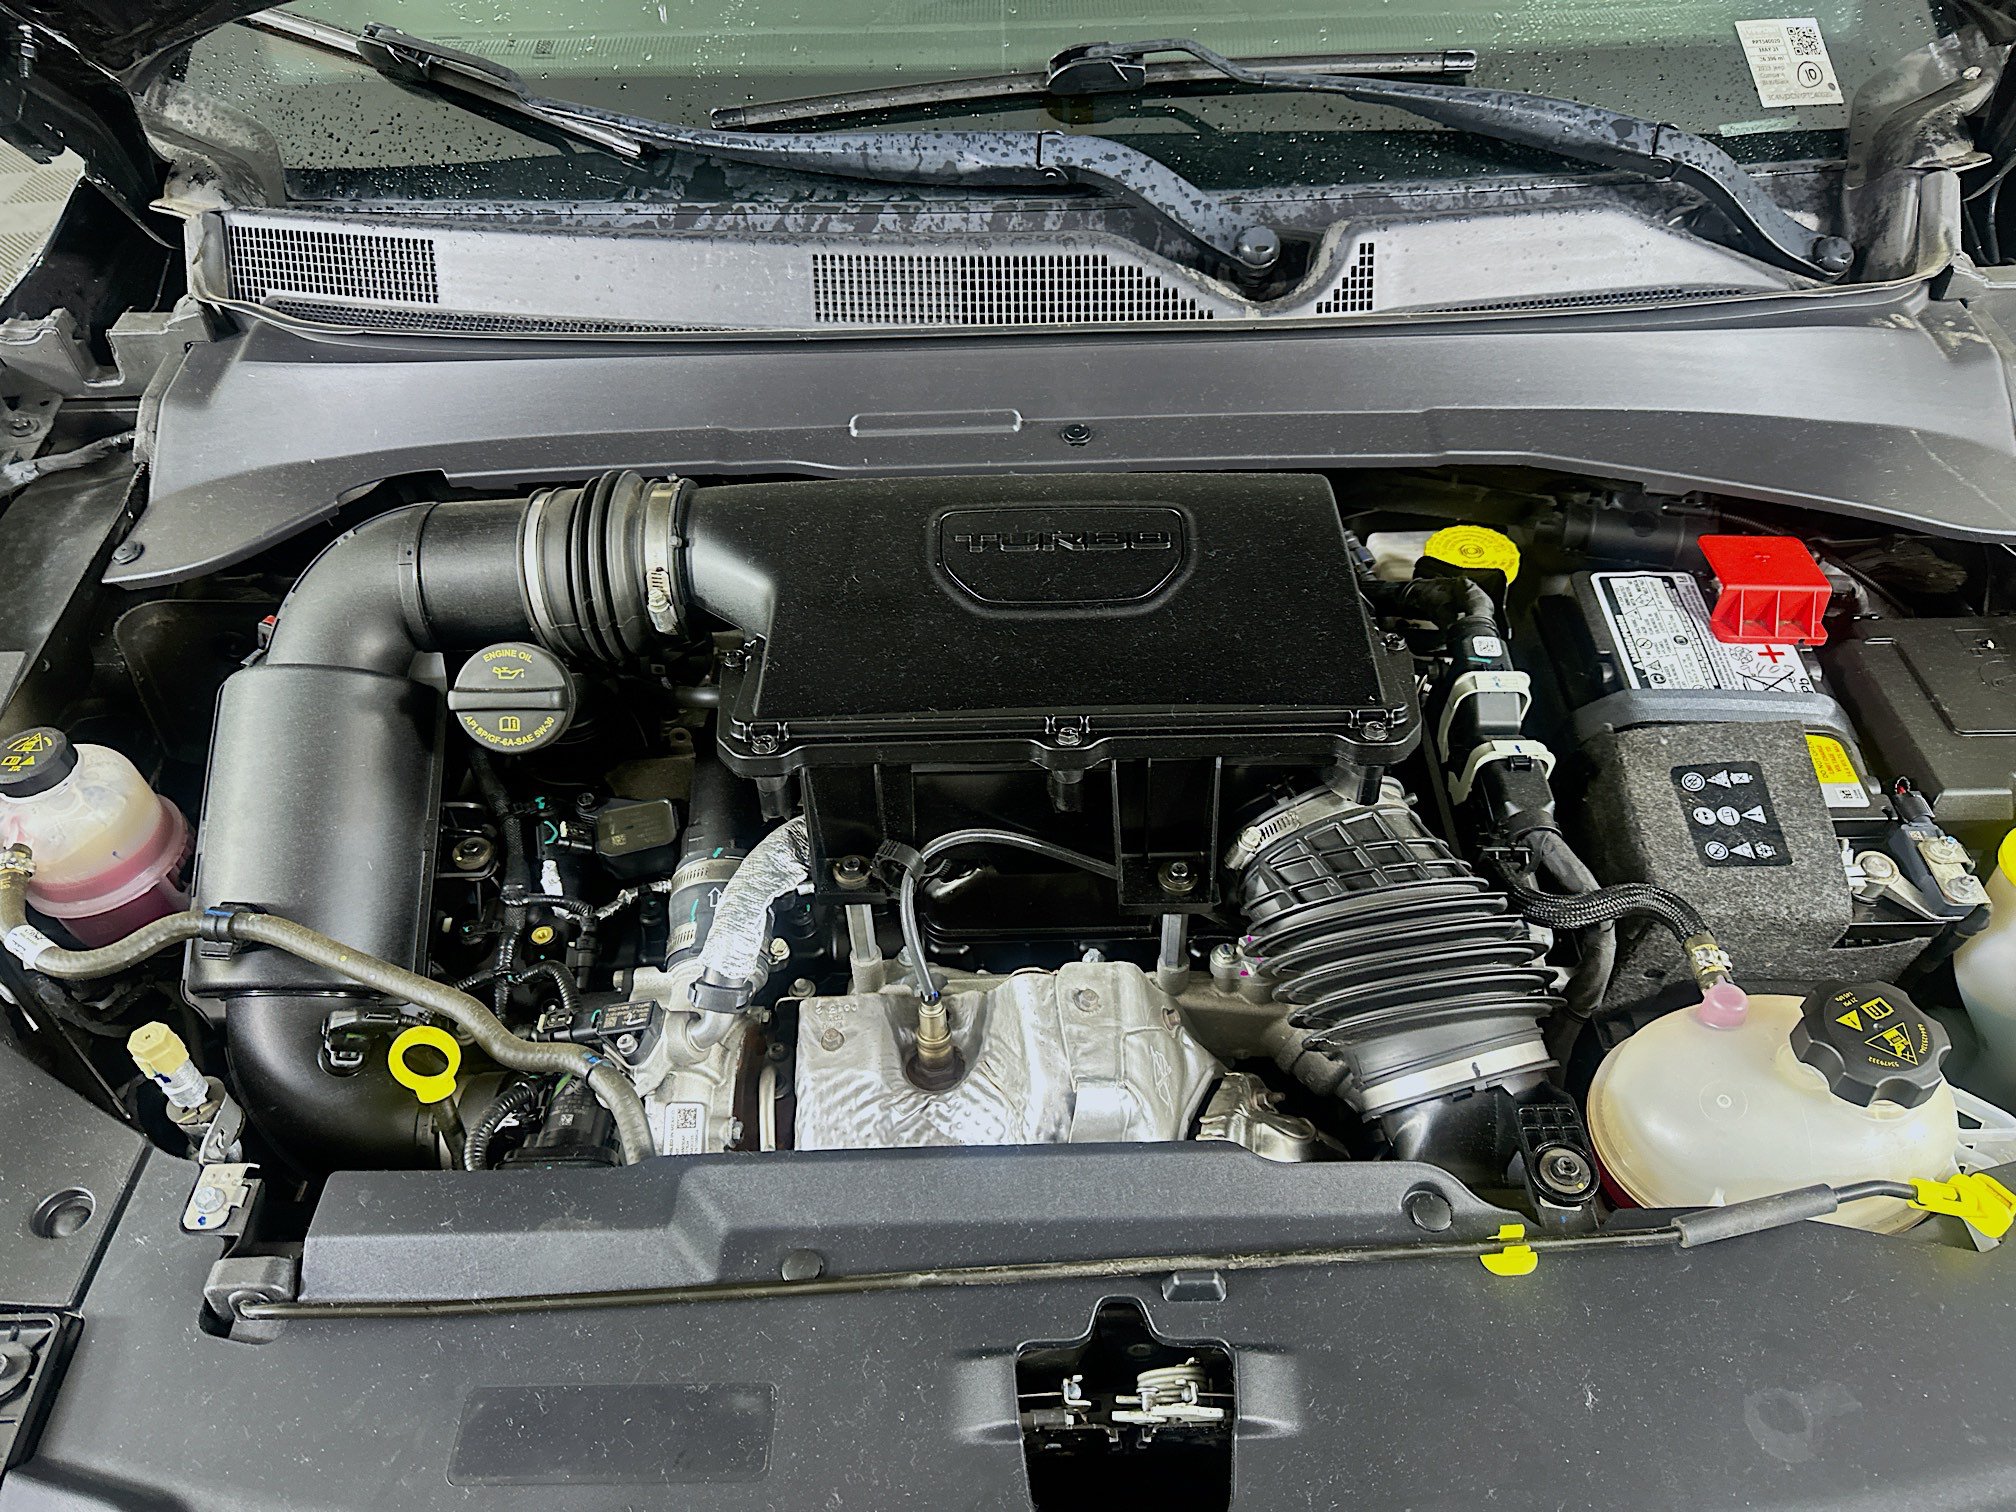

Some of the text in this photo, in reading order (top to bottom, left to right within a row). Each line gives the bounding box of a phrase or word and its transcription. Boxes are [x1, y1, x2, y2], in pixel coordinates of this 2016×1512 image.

[1805, 68, 1817, 82] 10
[954, 530, 1172, 553] TURBO
[483, 649, 533, 663] ENGINE OIL
[464, 716, 477, 730] API
[534, 716, 555, 738] 5W-30
